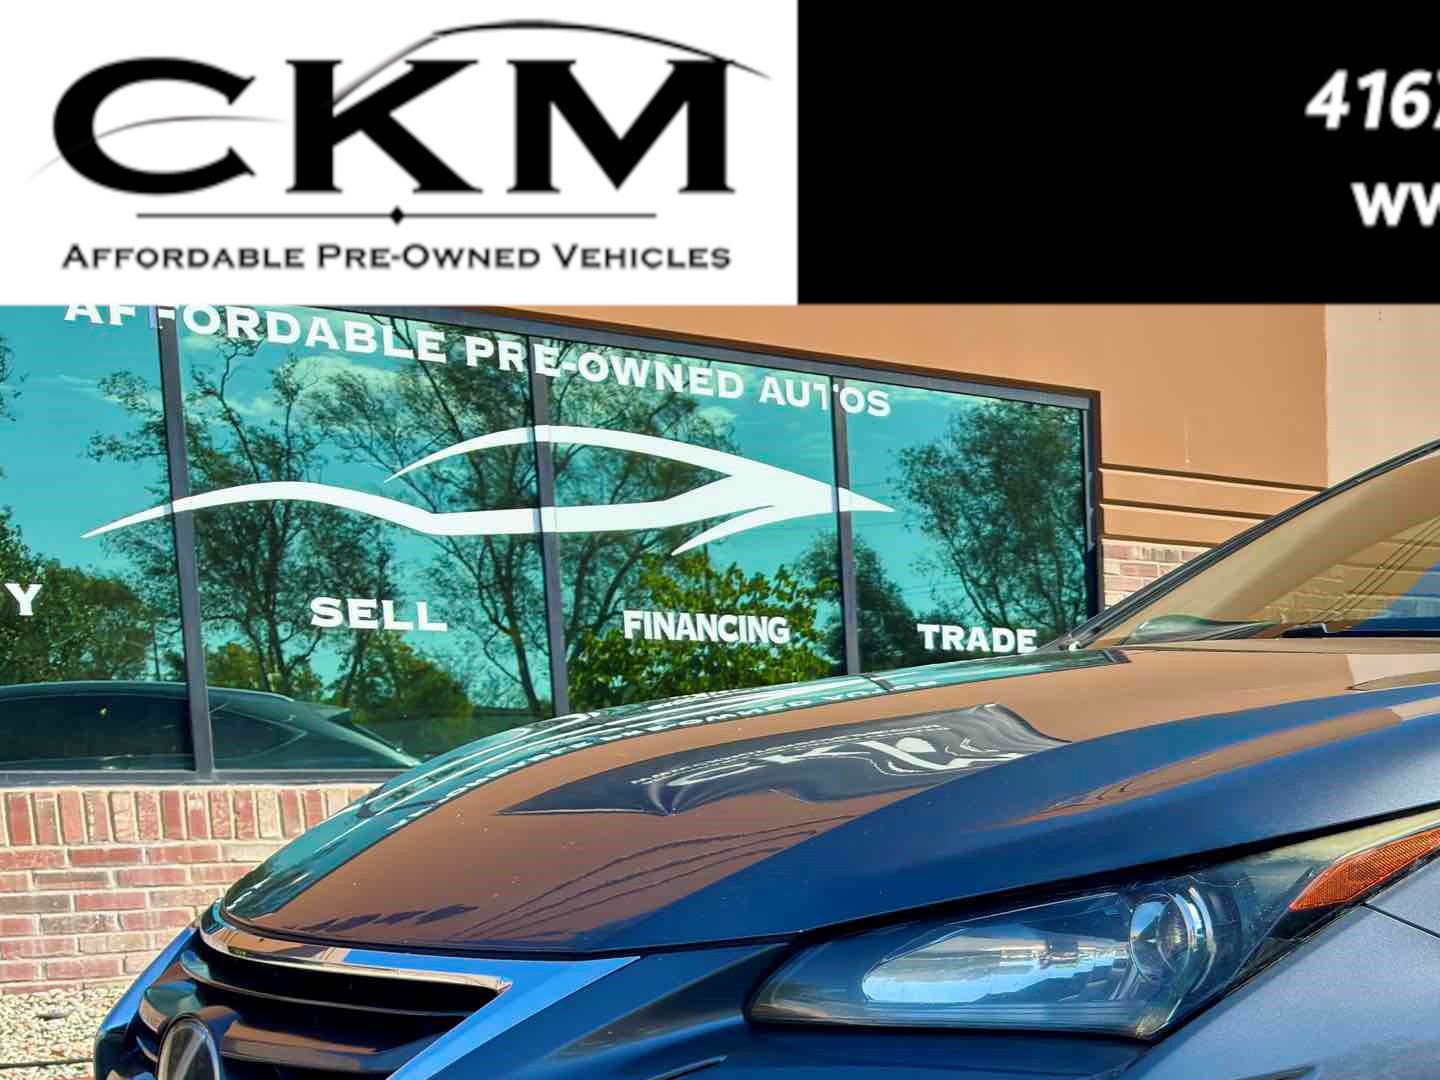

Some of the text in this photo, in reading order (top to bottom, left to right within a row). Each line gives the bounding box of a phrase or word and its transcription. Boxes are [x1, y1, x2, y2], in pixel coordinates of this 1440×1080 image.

[464, 335, 744, 399] PRE-OWNED
[759, 376, 890, 417] AUTOS
[310, 596, 448, 632] SELL
[623, 610, 791, 644] FINANCING
[916, 623, 1038, 655] TRADE
